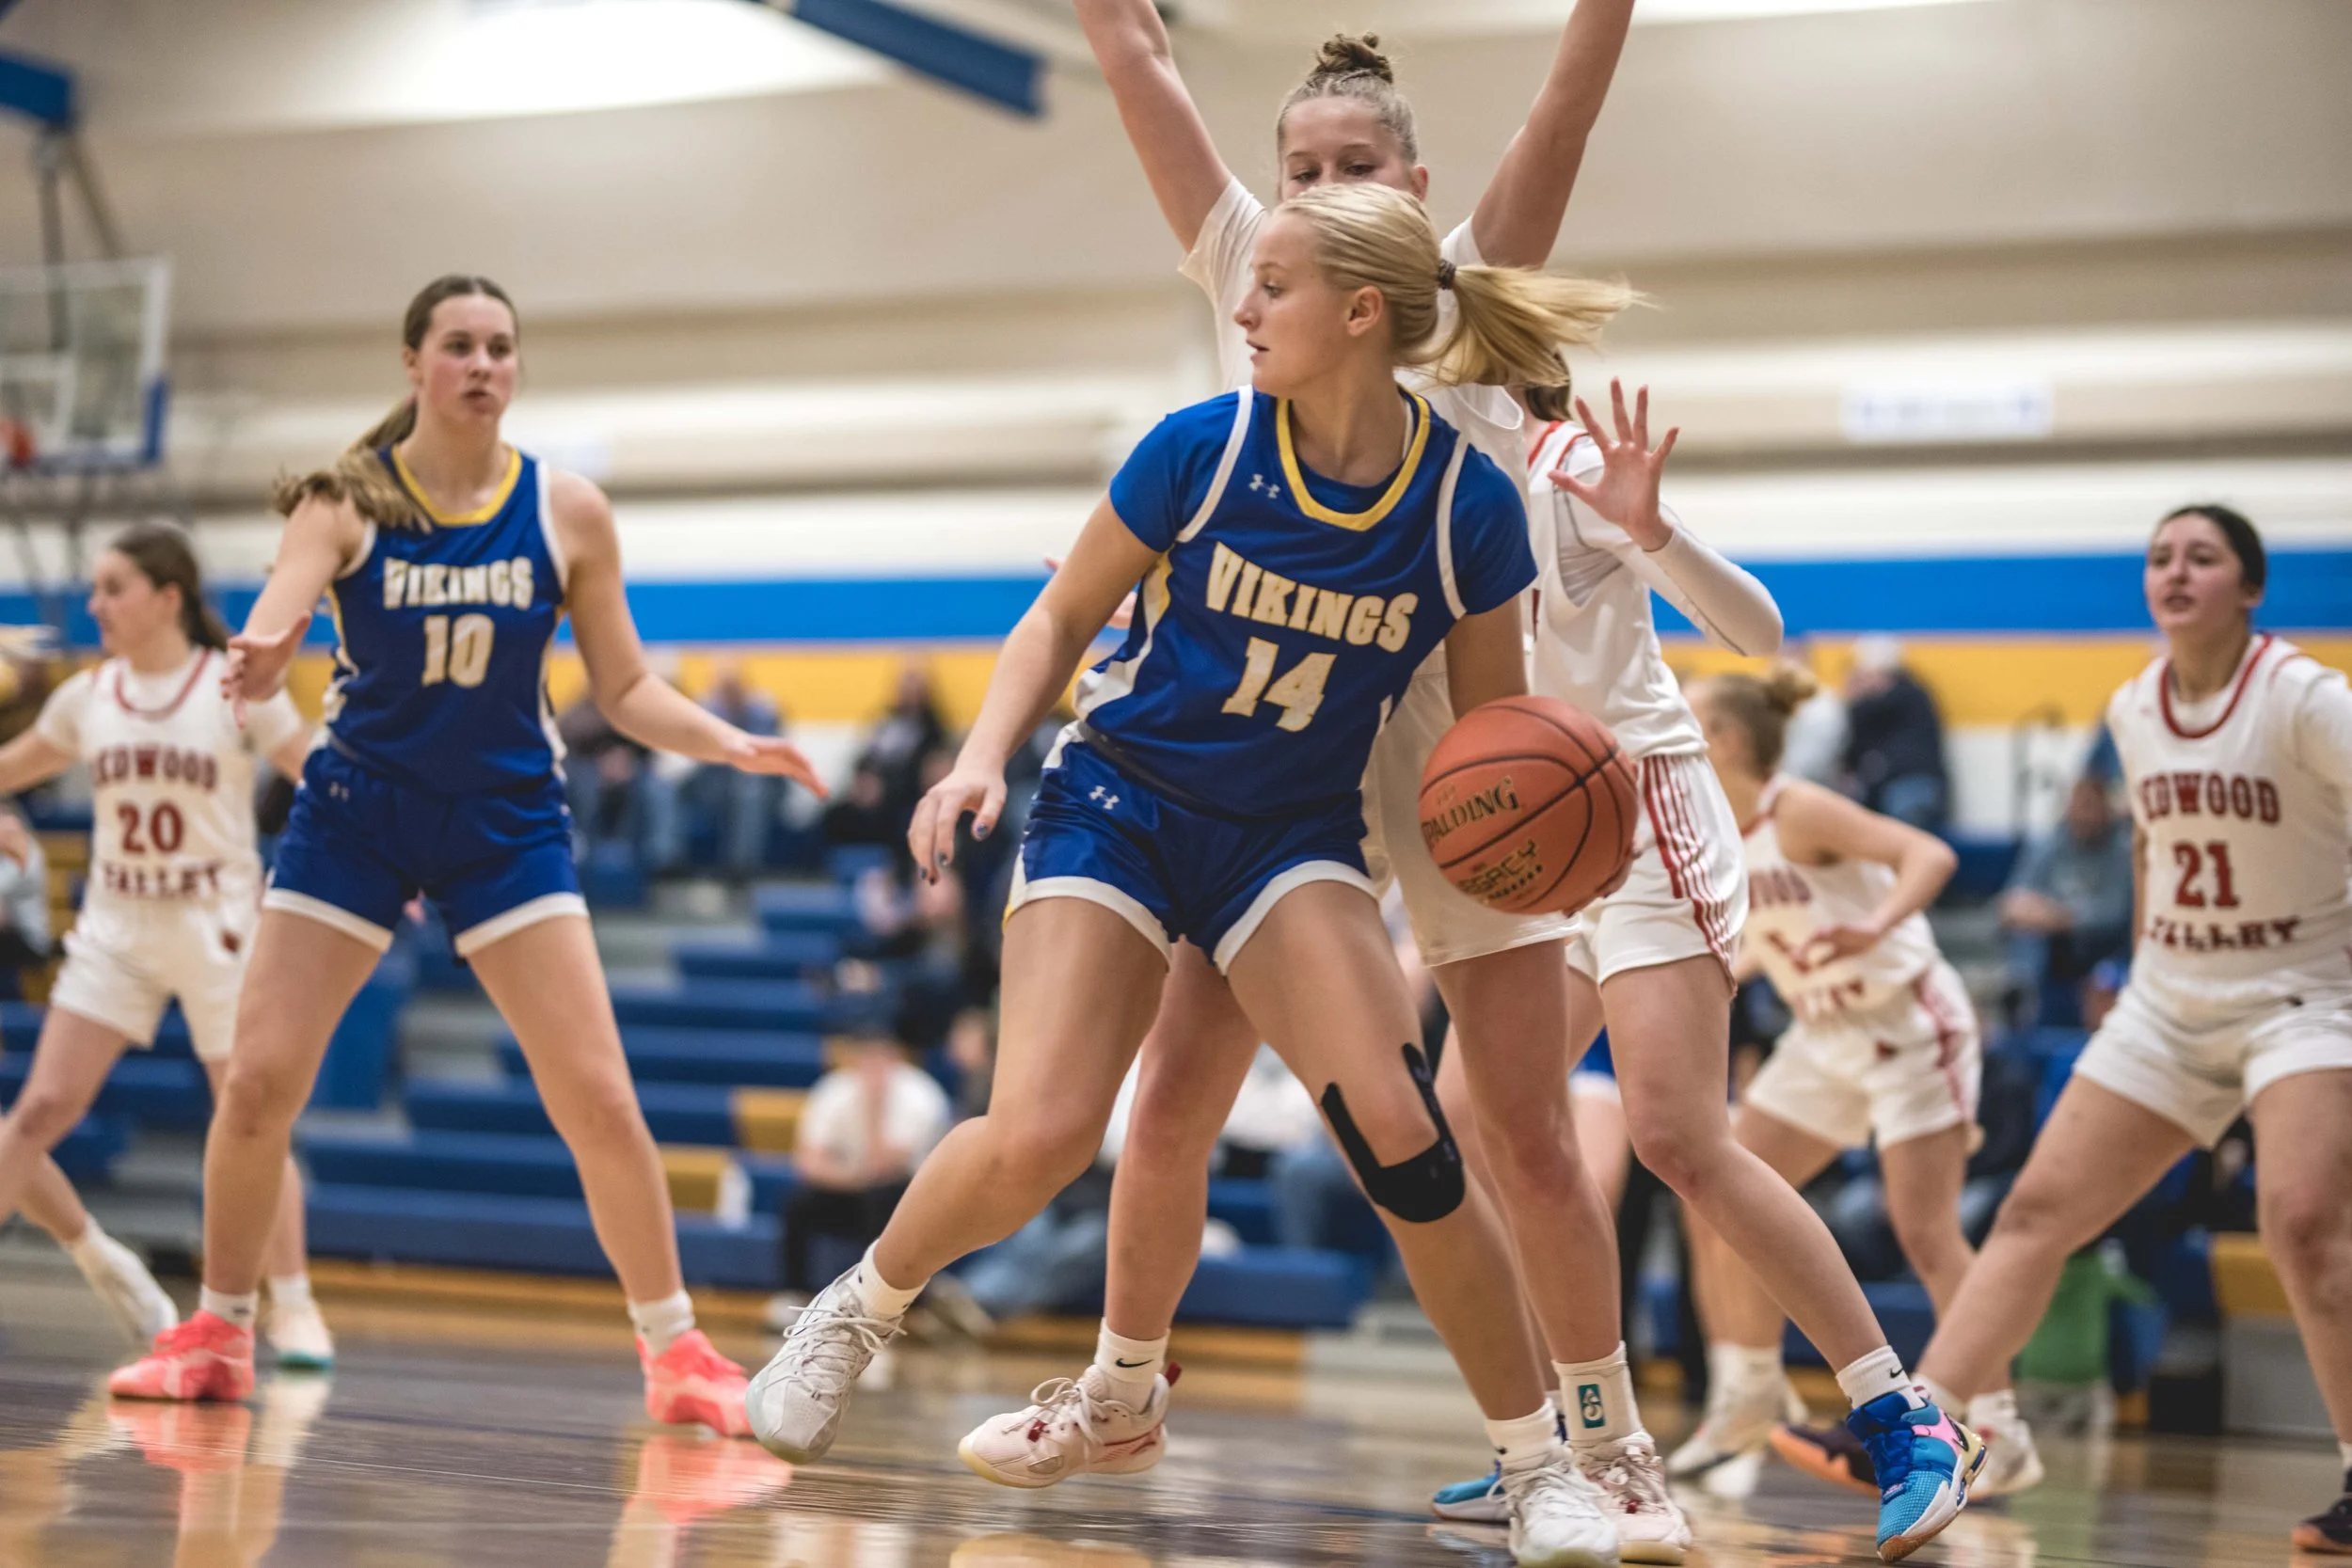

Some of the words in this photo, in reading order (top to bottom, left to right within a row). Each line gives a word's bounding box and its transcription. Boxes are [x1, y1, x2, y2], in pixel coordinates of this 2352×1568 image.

[383, 556, 533, 610] VIKINGS
[1206, 541, 1420, 653] VIKINGS
[421, 613, 495, 689] 10
[1220, 636, 1338, 732] 14
[94, 745, 217, 793] EDWOOD
[2138, 770, 2281, 828] EDWOOD
[117, 801, 183, 853] 20
[1420, 775, 1519, 850] PALDING
[2172, 840, 2240, 910] 21
